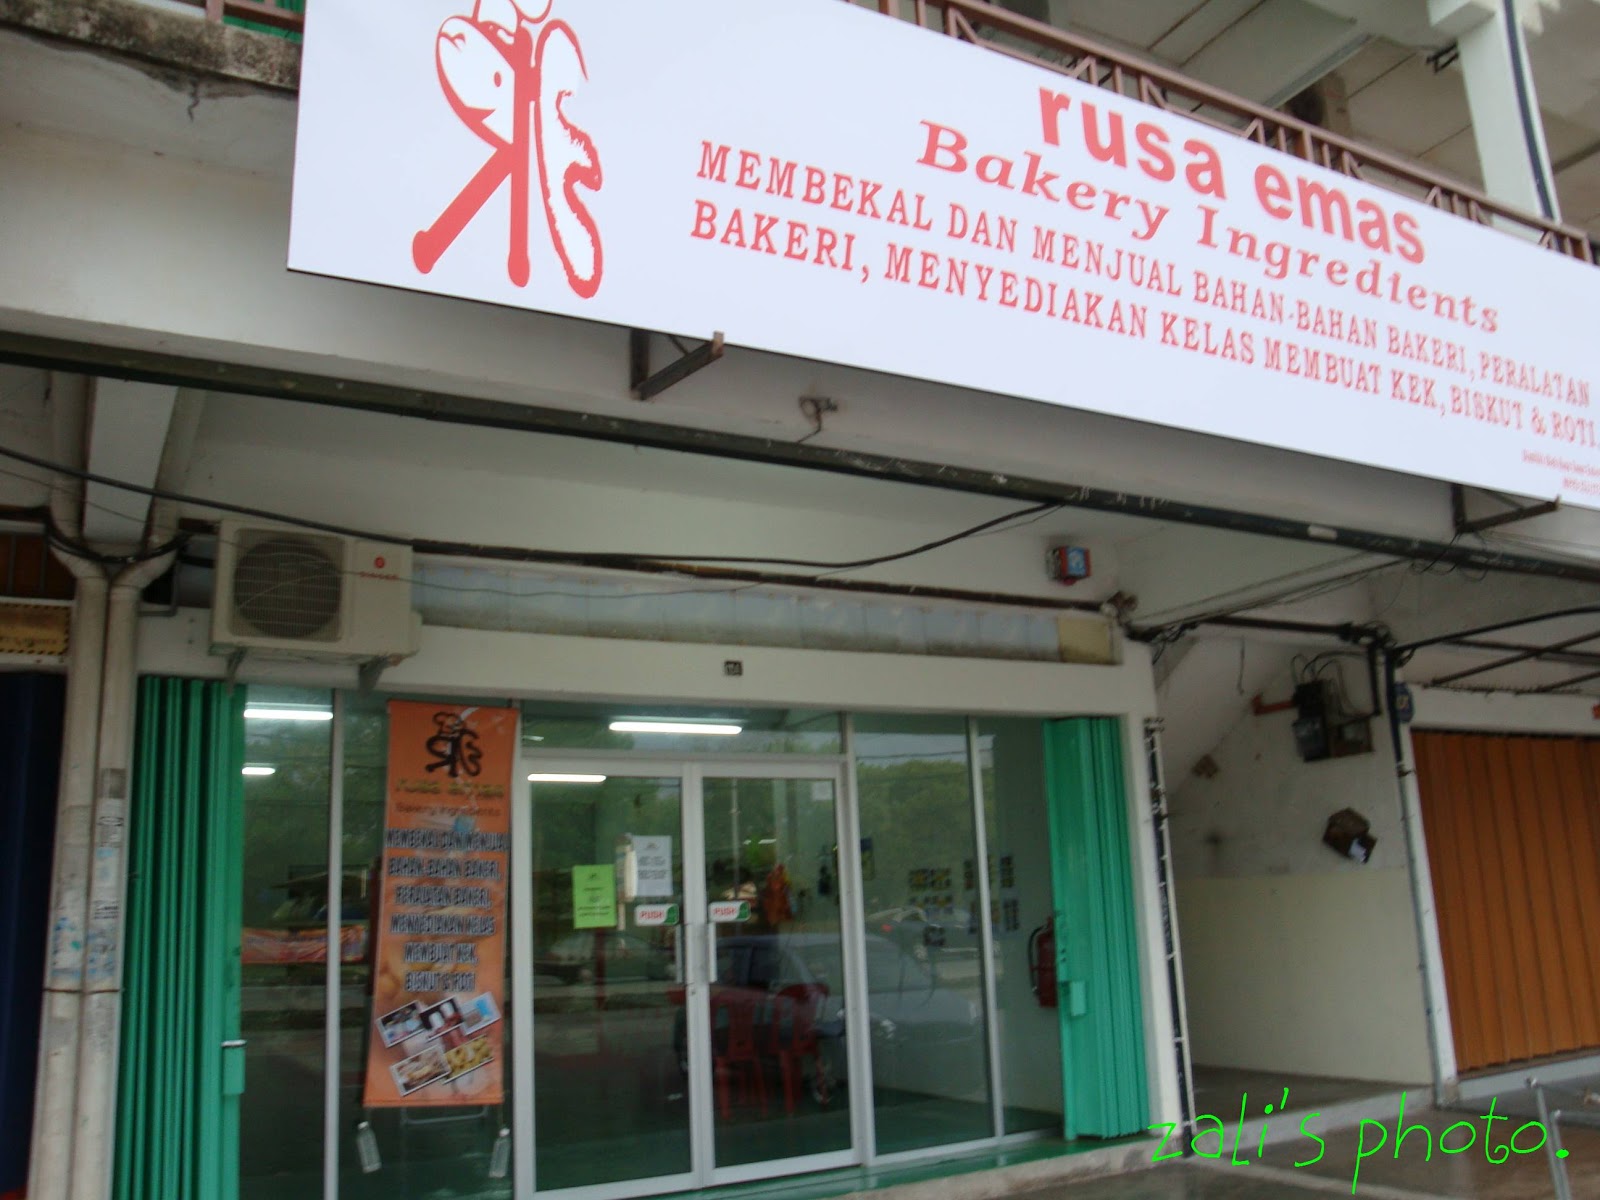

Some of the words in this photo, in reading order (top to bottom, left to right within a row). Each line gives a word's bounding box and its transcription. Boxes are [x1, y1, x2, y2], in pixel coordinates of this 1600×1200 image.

[694, 139, 934, 233] MEMBEKAL
[945, 202, 1018, 254] DAN
[1031, 224, 1183, 298] MENJUAL
[1191, 270, 1378, 350] BAHAN-BAHAN
[1386, 324, 1475, 382] BAKERI,
[1477, 351, 1591, 408] PERALATAN
[915, 119, 1171, 243] Bakery
[1196, 204, 1499, 335] Ingredients
[1037, 86, 1228, 201] rusa
[1252, 163, 1425, 265] emas
[689, 198, 870, 285] BAKERI,
[883, 242, 1148, 340] MENYEDIAKAN
[1159, 310, 1256, 367] KELAS
[1263, 336, 1382, 396] MEMBUAT
[1389, 368, 1446, 418] KEK,
[1448, 384, 1523, 431] BISKUT
[1530, 406, 1548, 437] &
